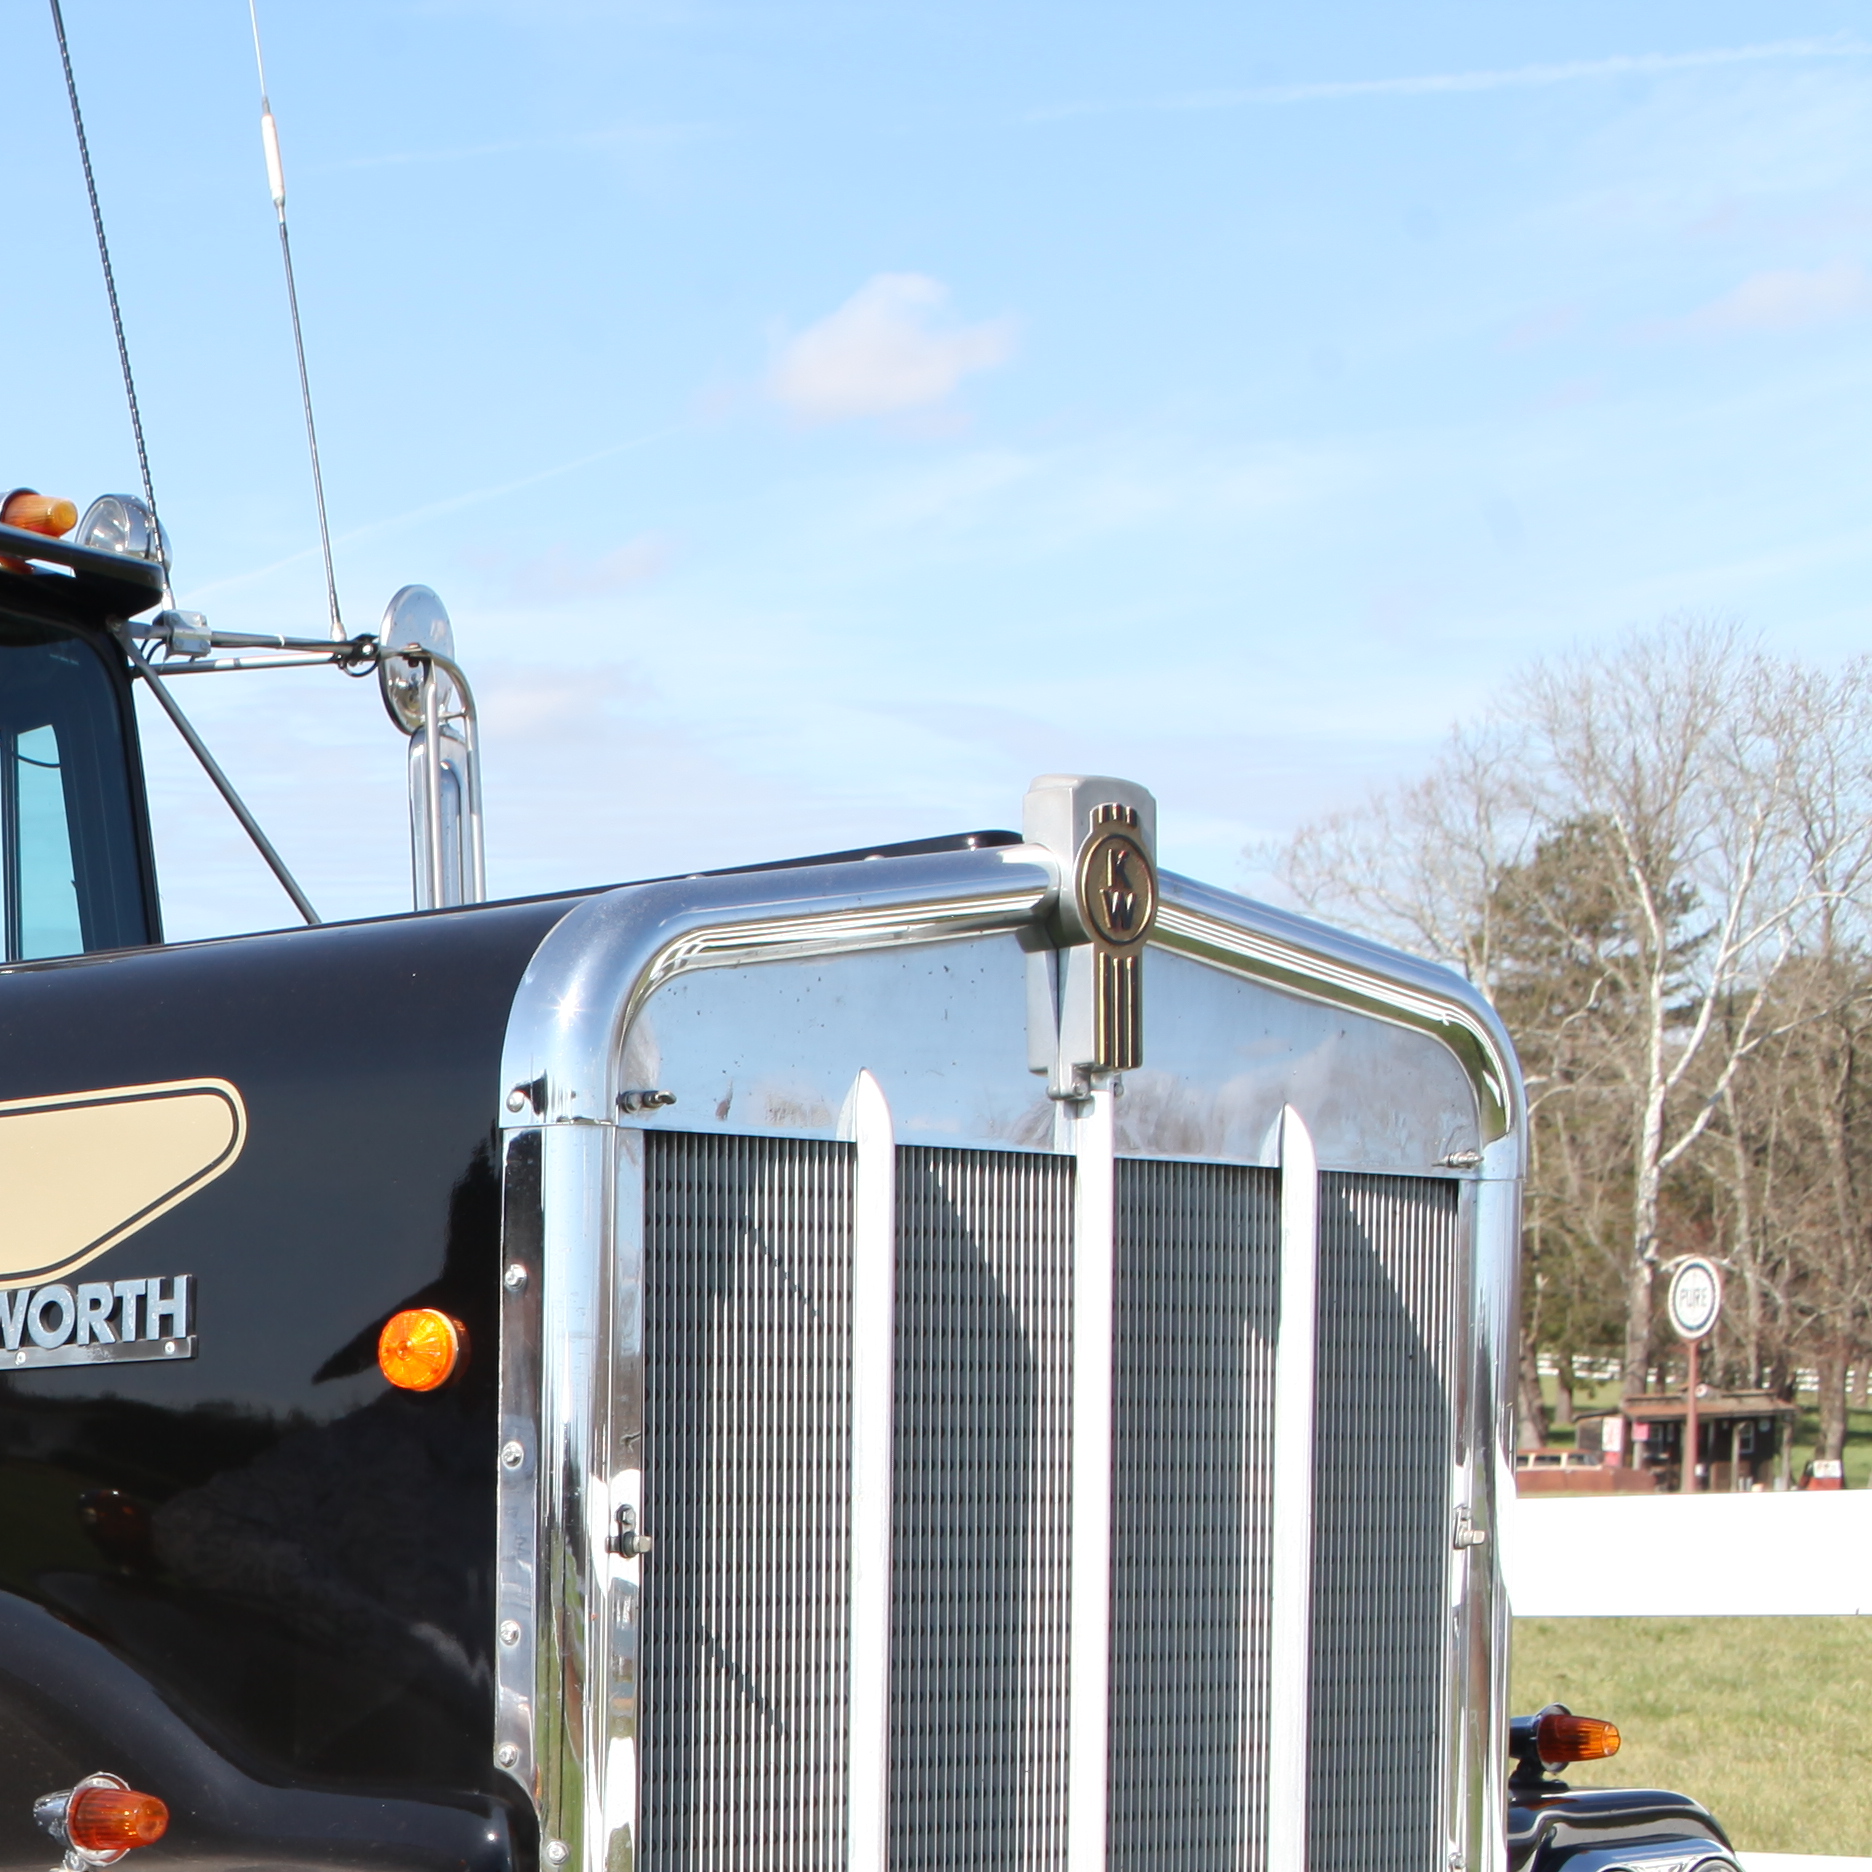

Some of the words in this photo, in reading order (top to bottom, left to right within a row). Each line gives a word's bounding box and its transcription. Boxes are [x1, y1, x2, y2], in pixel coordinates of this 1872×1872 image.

[1107, 848, 1132, 888] K
[1099, 888, 1138, 930] W
[1679, 1286, 1708, 1308] PURE
